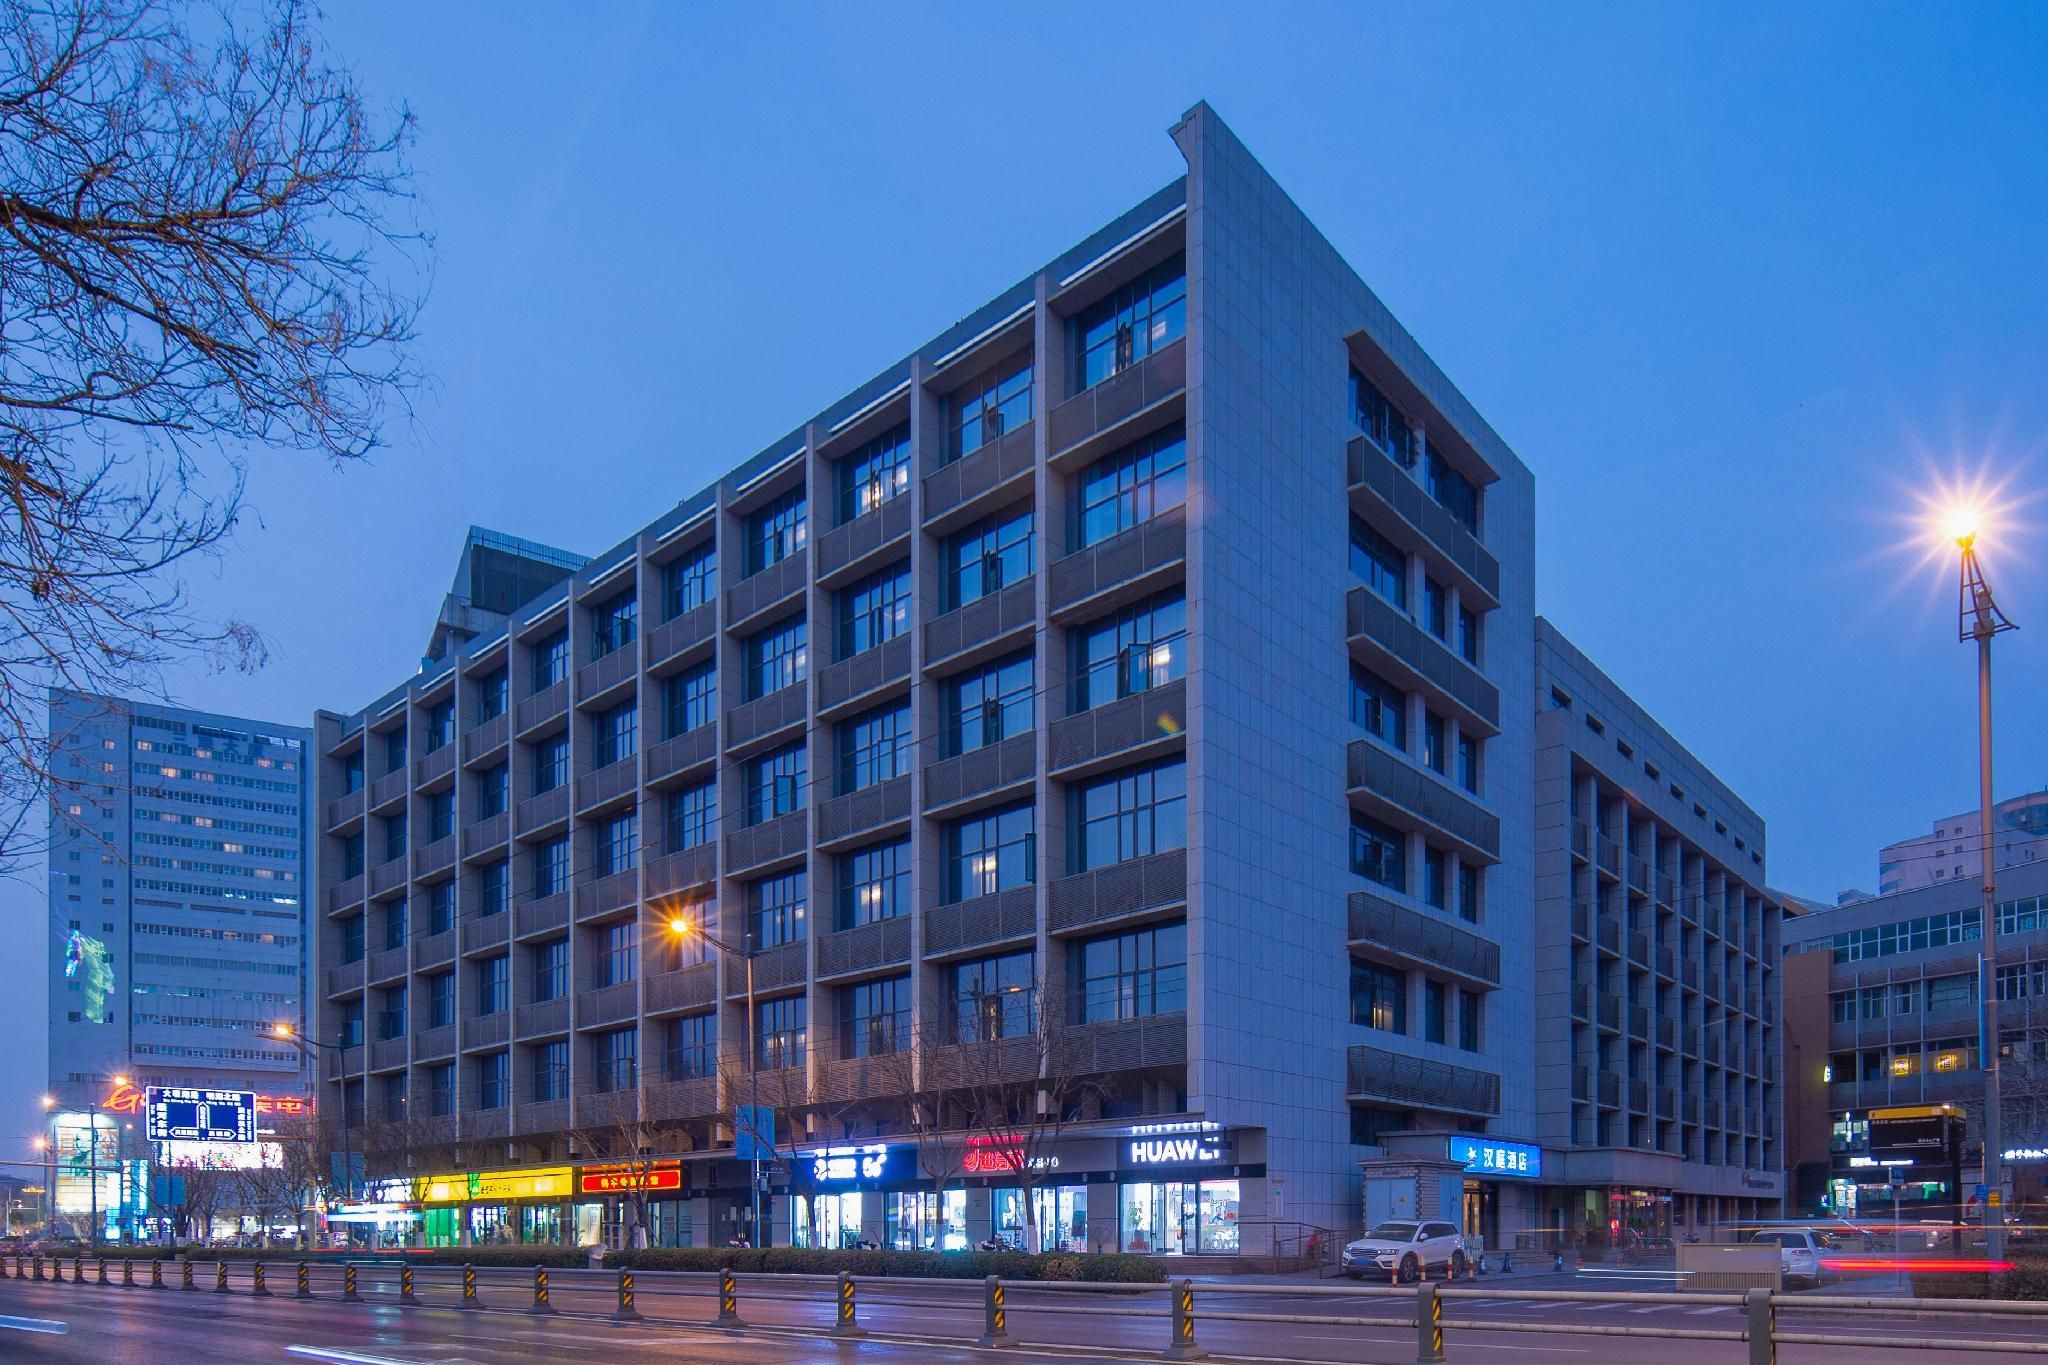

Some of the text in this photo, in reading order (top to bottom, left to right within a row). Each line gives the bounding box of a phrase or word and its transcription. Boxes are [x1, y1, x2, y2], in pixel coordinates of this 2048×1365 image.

[1132, 1137, 1219, 1162] HUAWEI
[1483, 1147, 1527, 1170] 汉庭酒店
